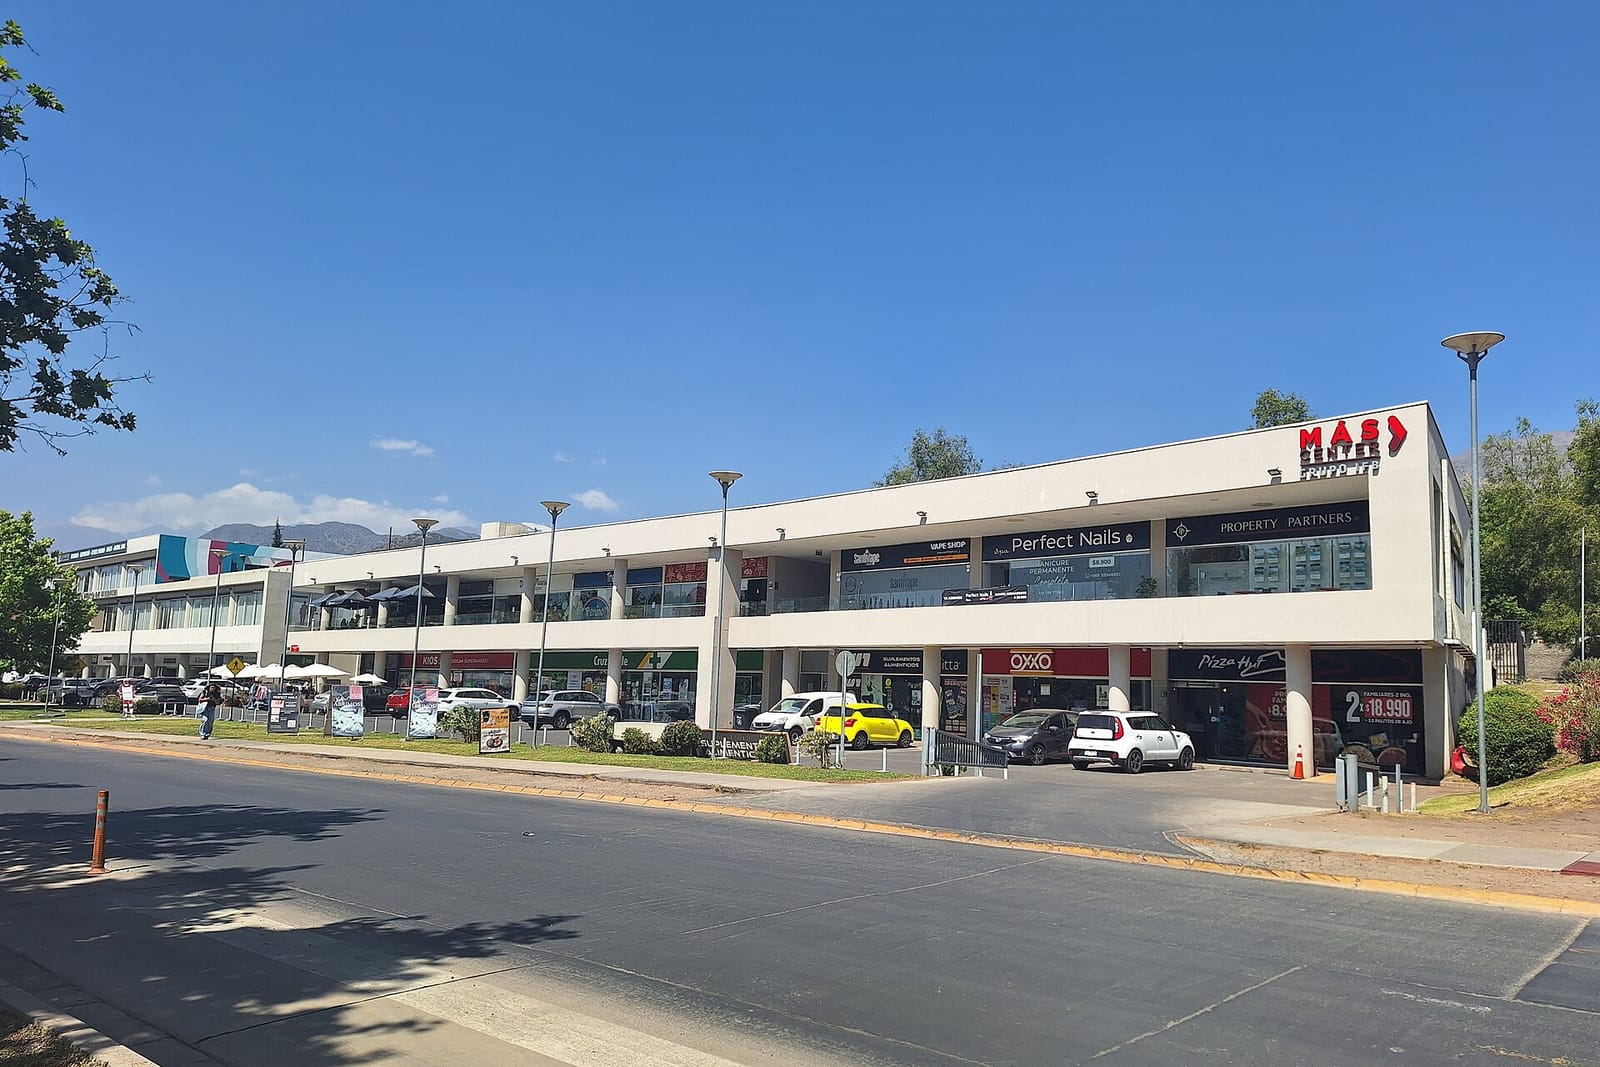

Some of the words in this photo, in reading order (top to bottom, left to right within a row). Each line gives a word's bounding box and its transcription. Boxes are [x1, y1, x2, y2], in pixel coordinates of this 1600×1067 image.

[1300, 441, 1380, 461] CENTER
[1299, 463, 1347, 479] GRUPO
[1220, 518, 1279, 533] PROPERTY
[1287, 511, 1352, 527] PARTNERS
[930, 542, 947, 550] VAPE
[947, 541, 967, 549] SHOP
[1011, 533, 1074, 552] Perfect
[1079, 528, 1121, 547] Nails
[1029, 566, 1075, 575] PERMANENTE
[422, 656, 440, 666] KIOS
[1010, 653, 1052, 671] OXXO
[1198, 654, 1236, 669] Pizza
[1237, 656, 1265, 672] Hut
[1345, 691, 1361, 723] 2
[700, 739, 758, 750] SUPLEMENT
